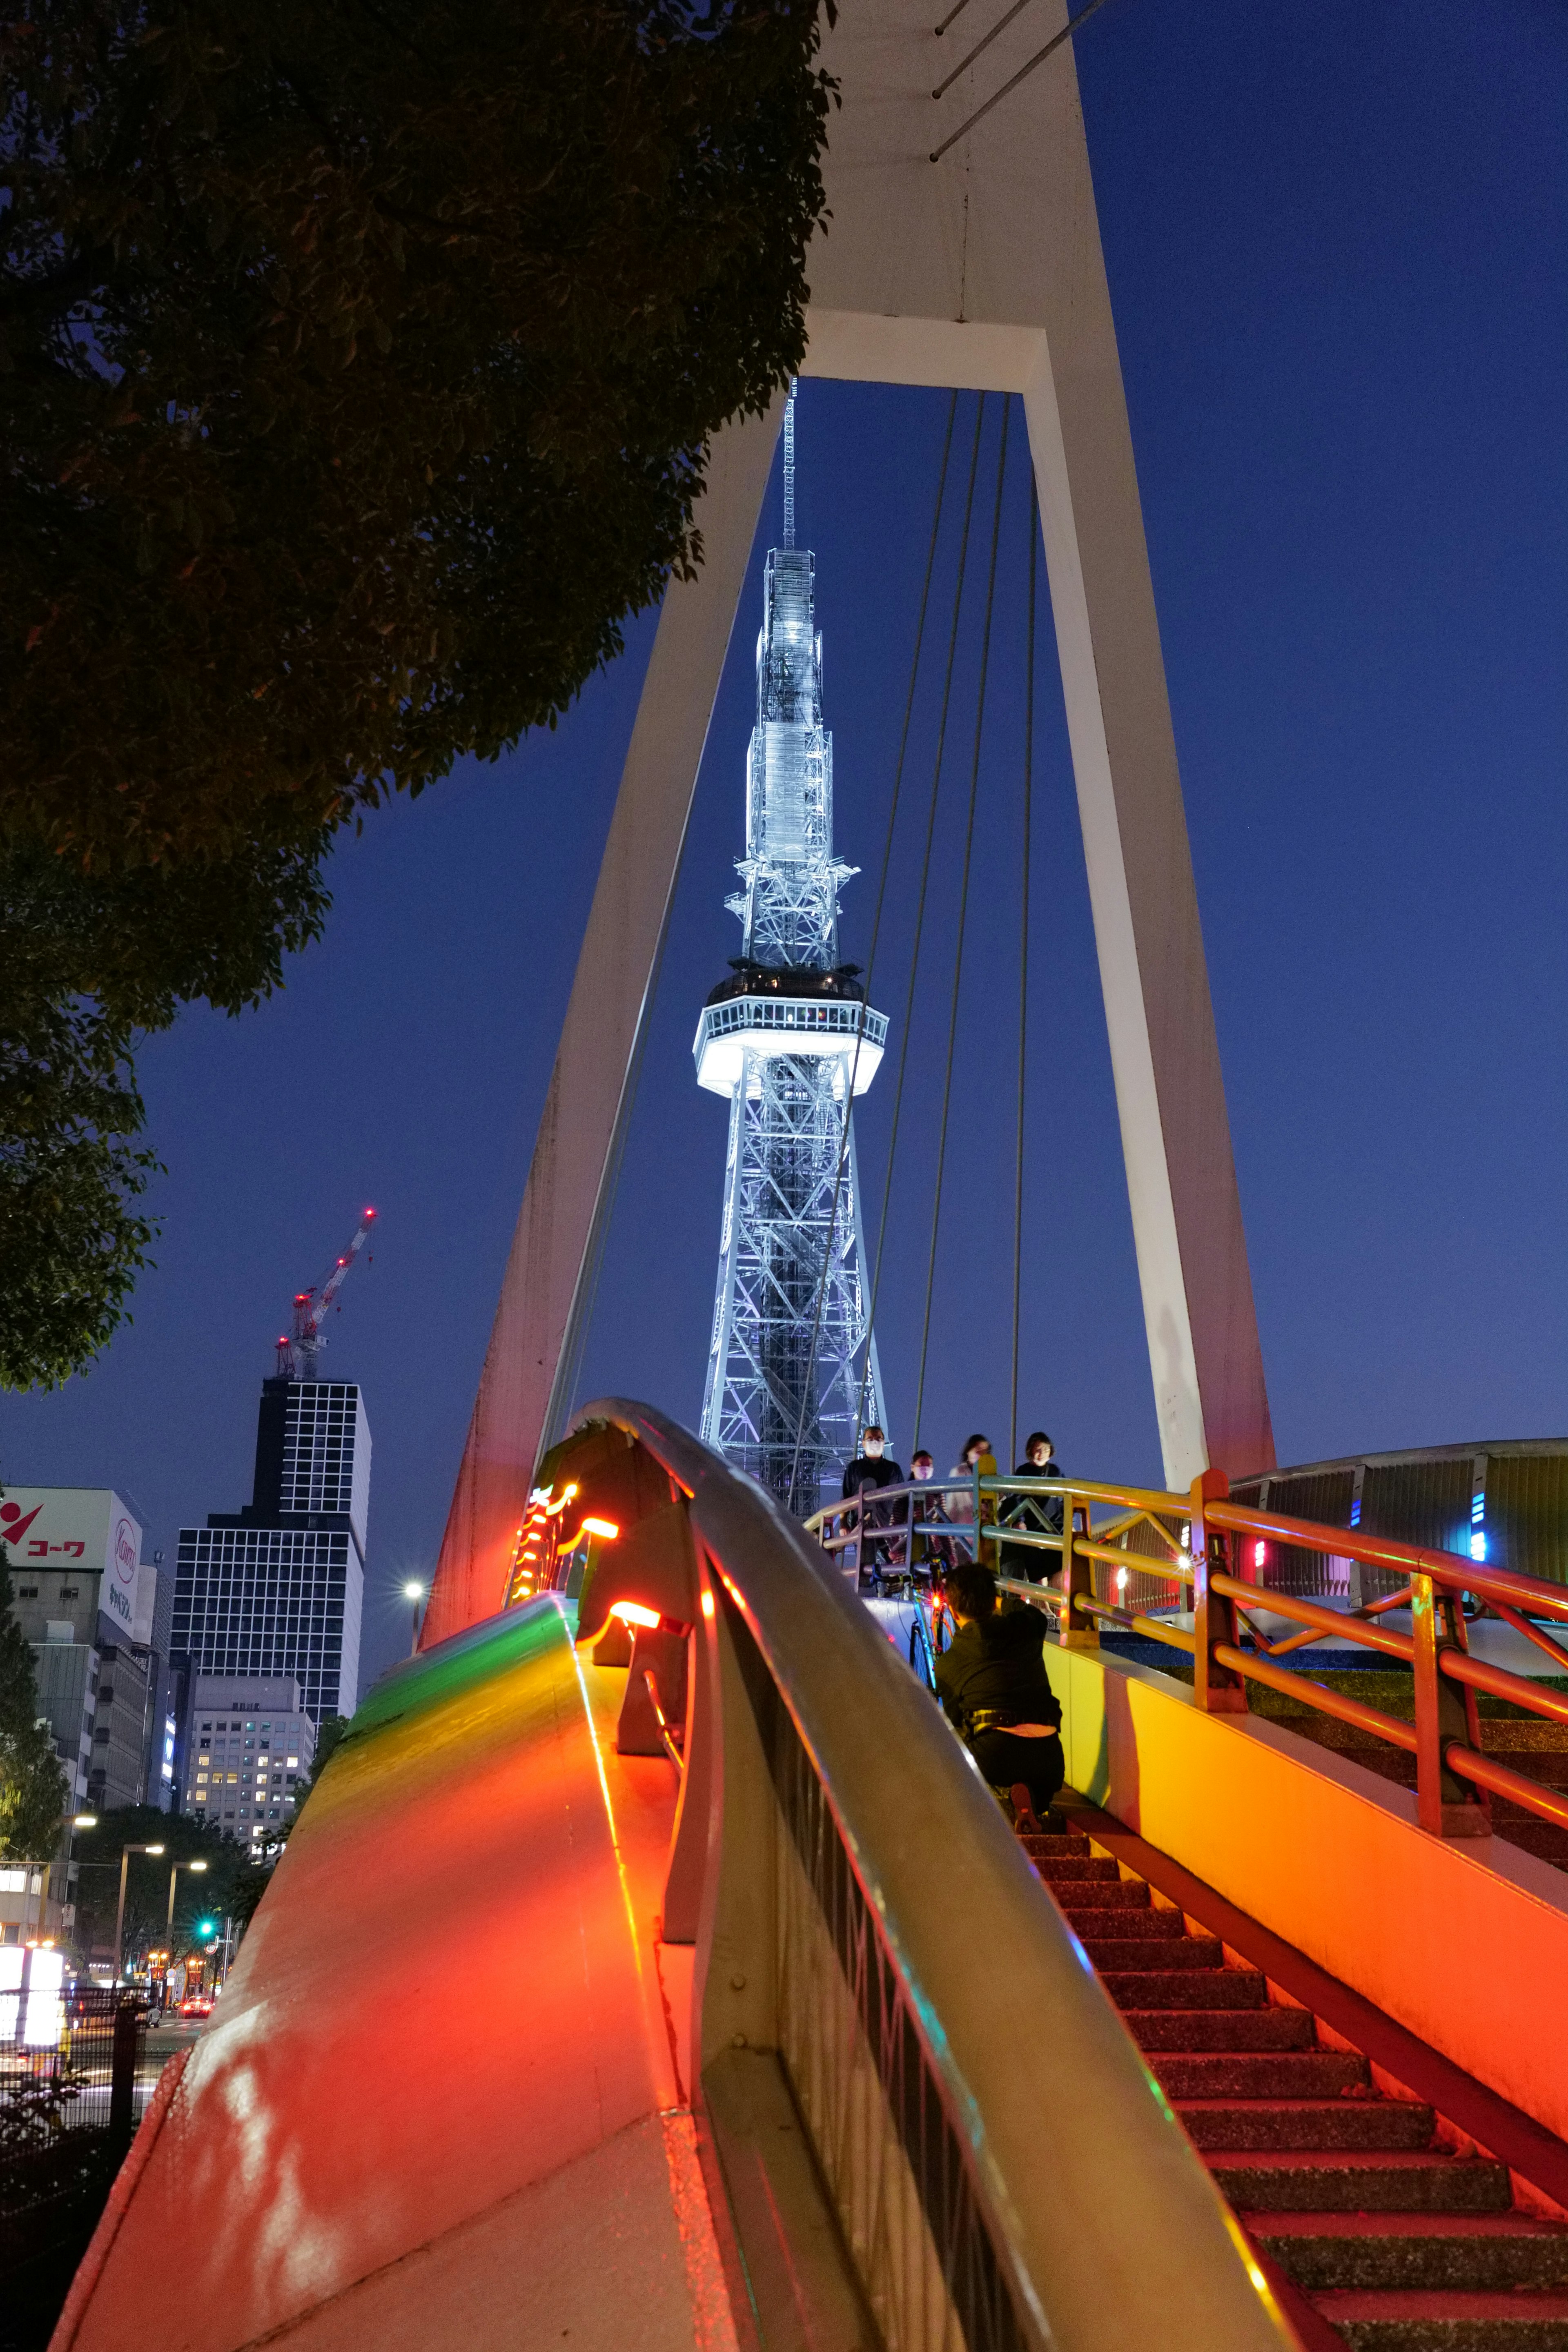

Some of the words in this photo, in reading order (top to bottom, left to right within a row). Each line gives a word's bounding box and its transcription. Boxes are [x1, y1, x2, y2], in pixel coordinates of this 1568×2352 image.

[28, 1541, 85, 1557] コーワ
[117, 1525, 135, 1572] Kowa
